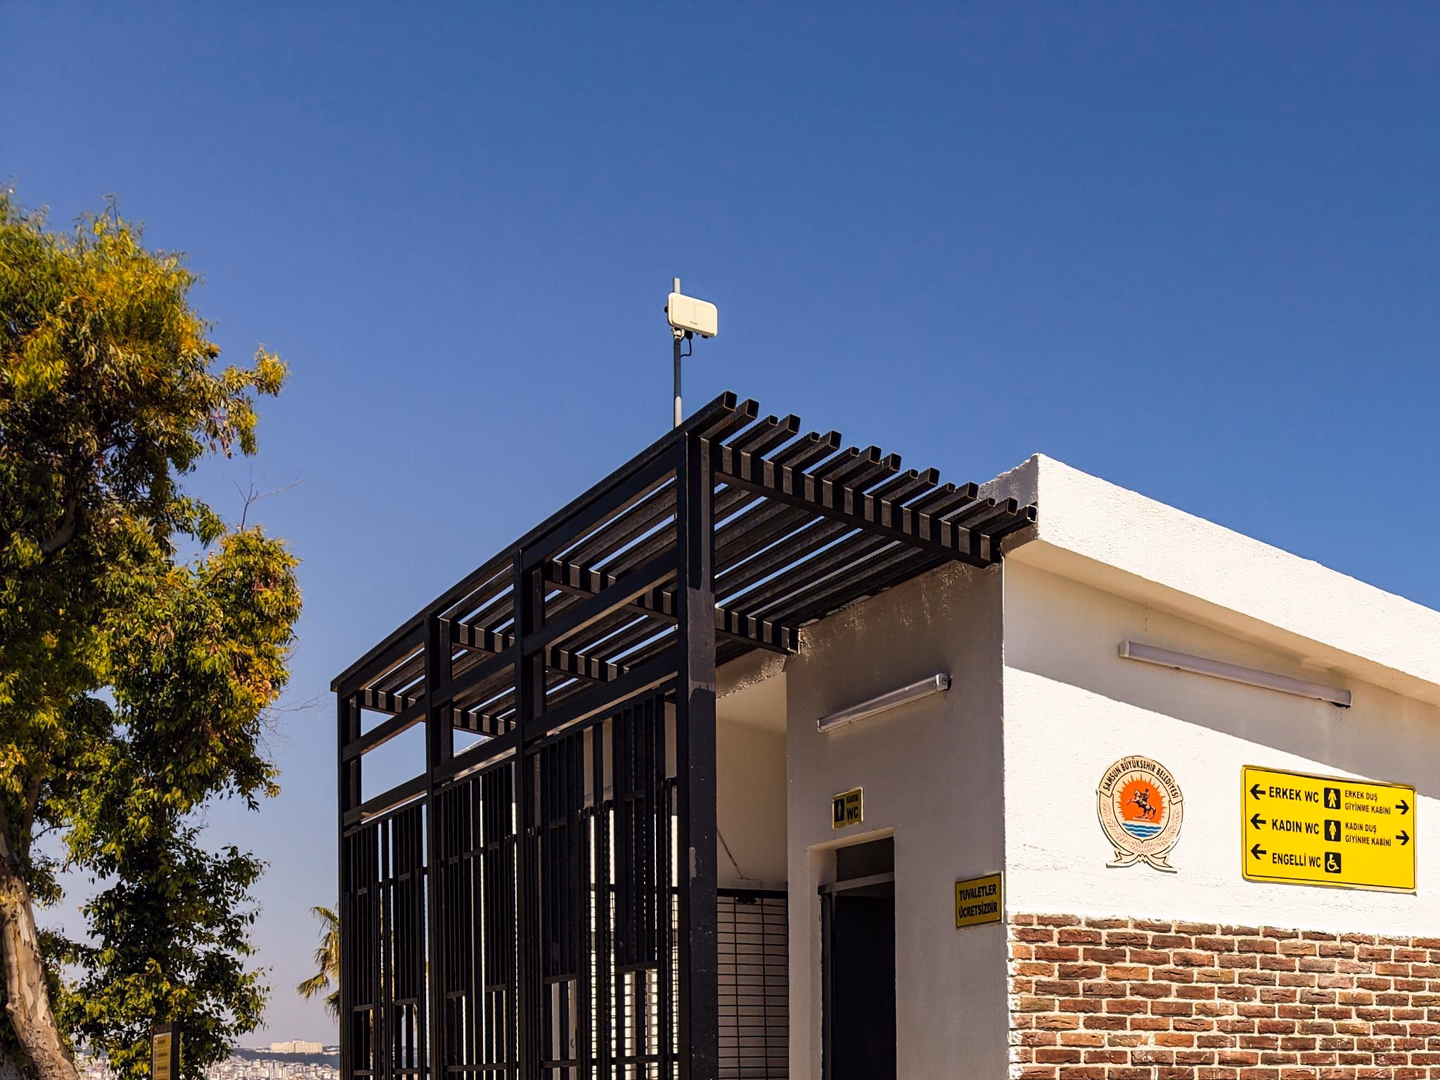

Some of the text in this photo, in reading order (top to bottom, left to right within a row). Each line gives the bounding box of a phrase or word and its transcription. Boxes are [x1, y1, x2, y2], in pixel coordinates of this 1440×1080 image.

[1103, 766, 1122, 791] SAMSUN
[1269, 786, 1319, 803] ERKEK WC
[1345, 790, 1378, 803] ERKEK DUŞ
[847, 806, 859, 820] WC
[1345, 801, 1391, 815] GİYİNME KABİNİ
[1272, 819, 1320, 835] KADIN WC
[1345, 822, 1377, 835] KADIN DUŞ
[1345, 833, 1391, 847] GİYİNME KABİNİ
[1272, 852, 1321, 868] ENGELLİ WC
[959, 884, 997, 901] TUVALETLER
[959, 900, 998, 918] ÜCRETSİZDİR
